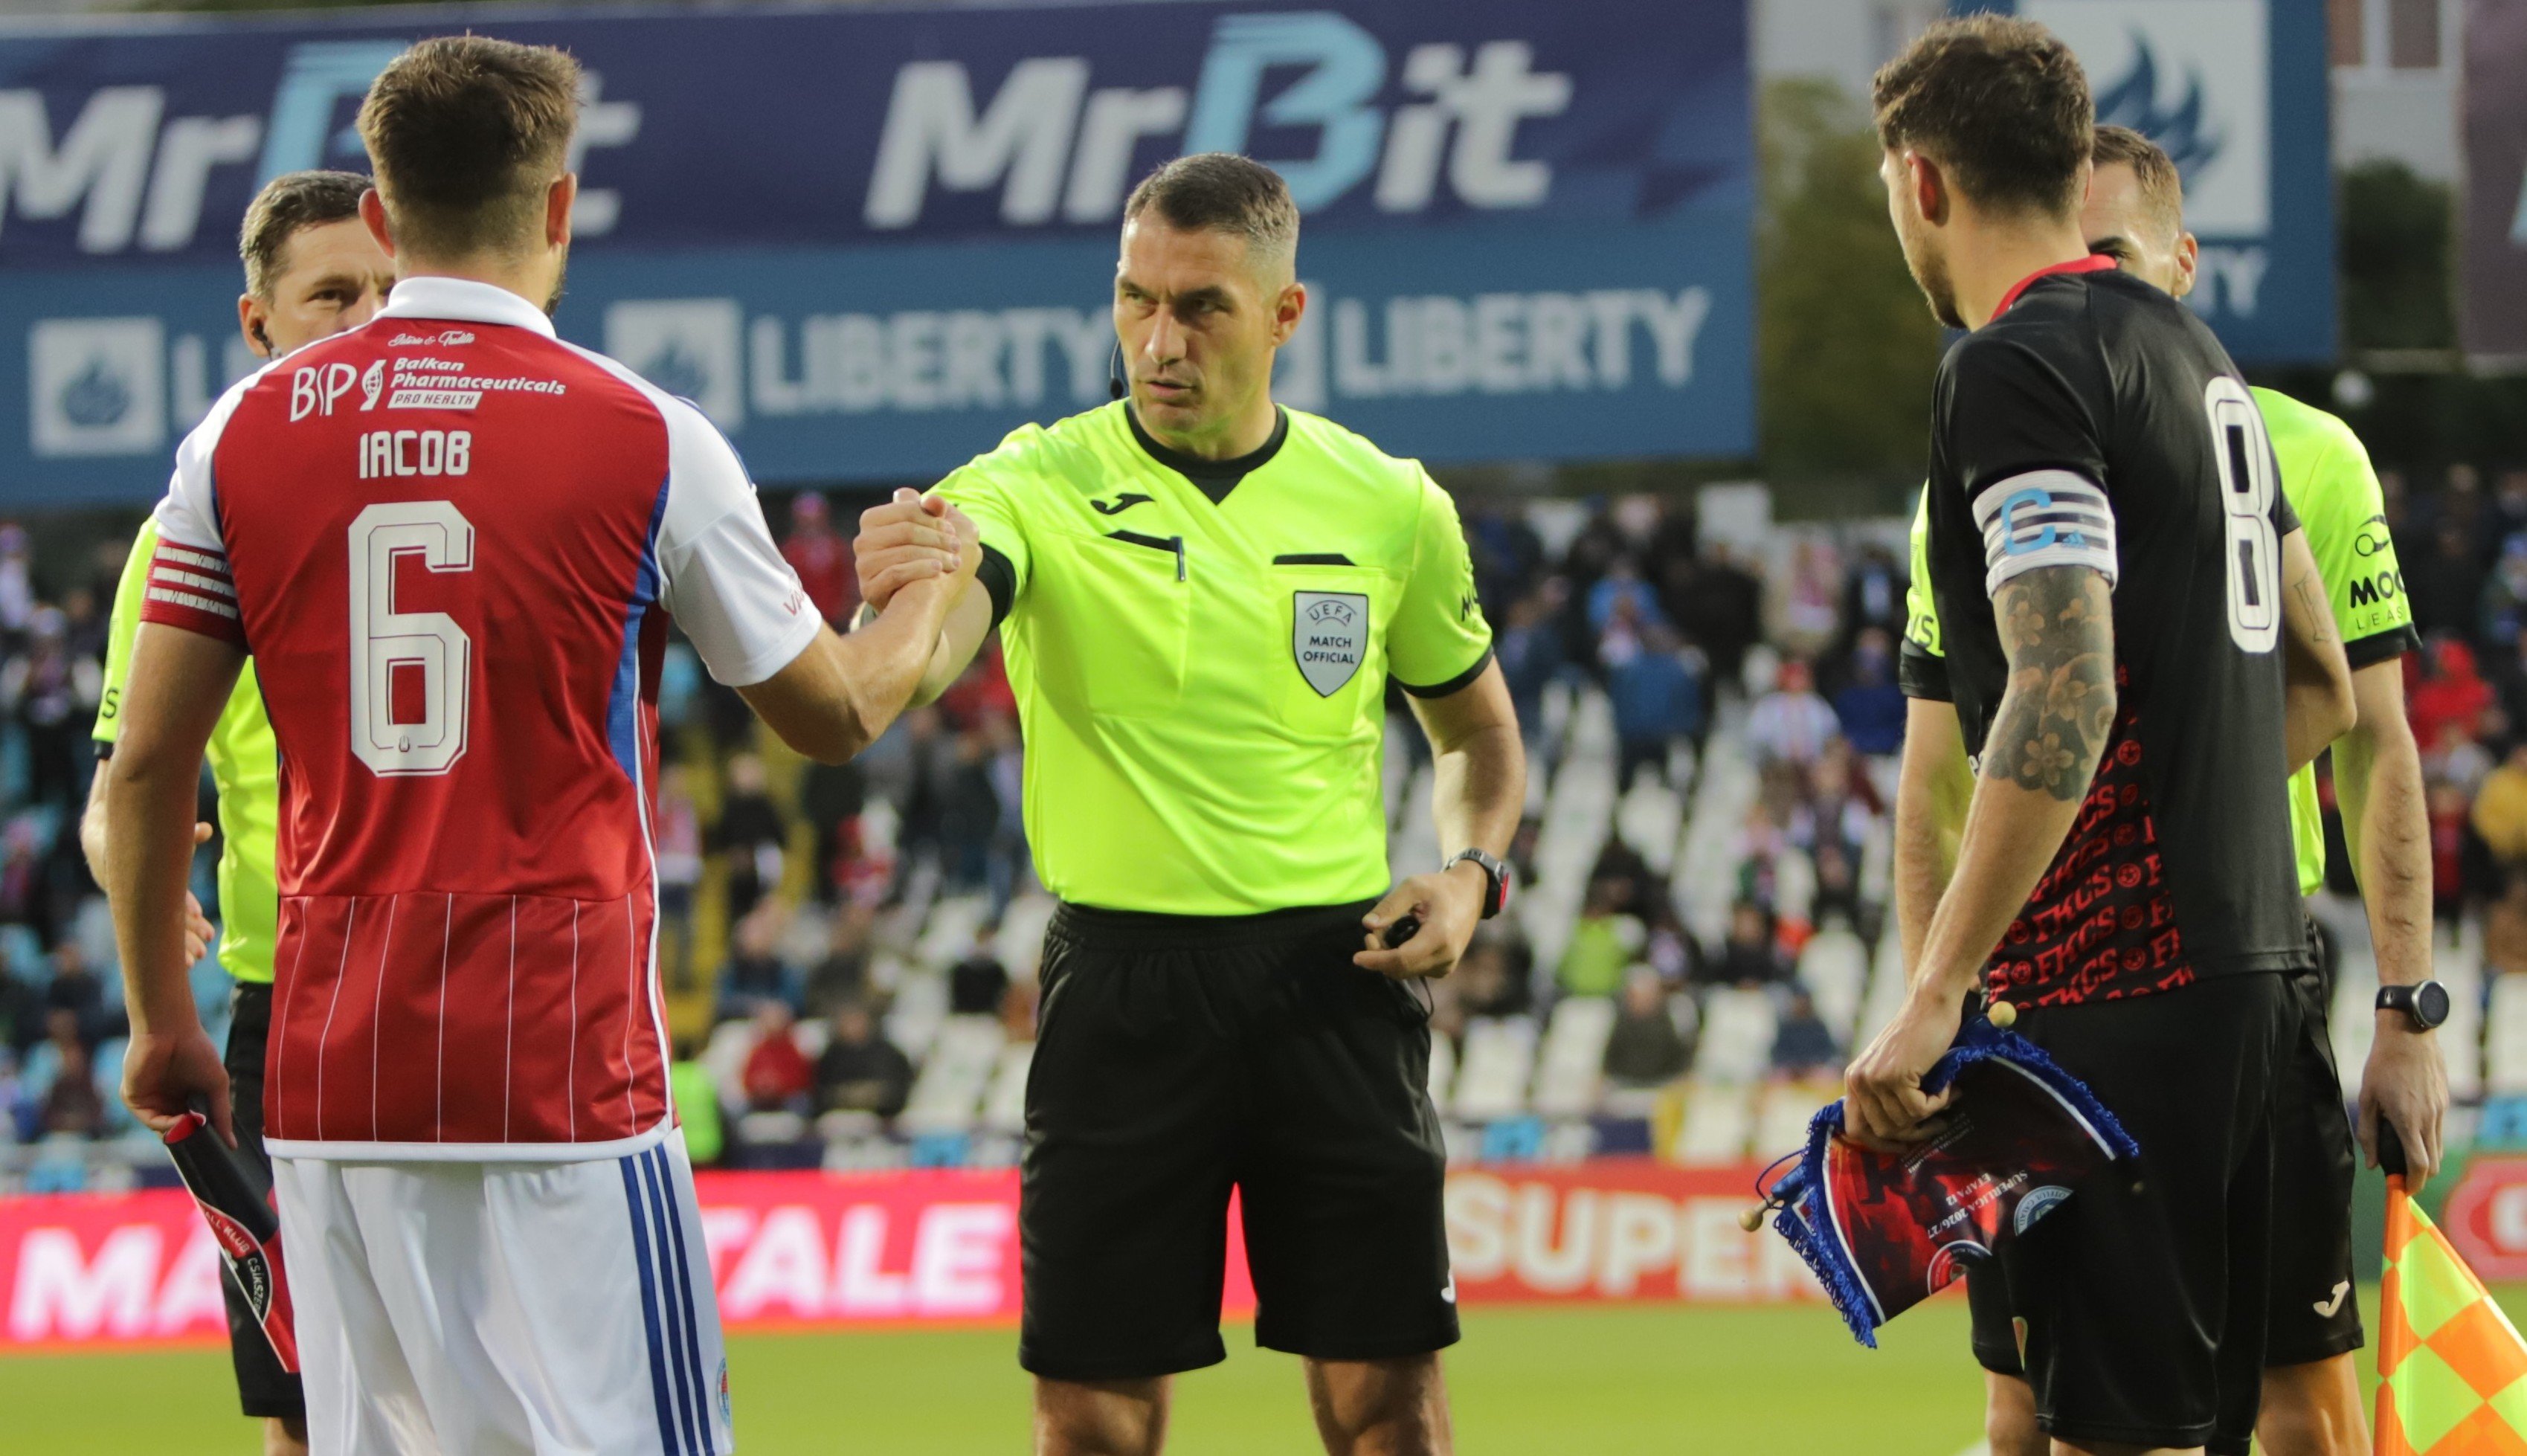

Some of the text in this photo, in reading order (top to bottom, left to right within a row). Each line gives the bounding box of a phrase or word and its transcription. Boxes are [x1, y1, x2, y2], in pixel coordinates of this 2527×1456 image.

[864, 10, 1574, 229] MrBit
[750, 306, 1116, 415] LIBERTY
[1336, 286, 1710, 399] LIBERTY
[390, 372, 567, 396] Pharmaceuticals
[393, 357, 465, 373] Balkan
[394, 393, 474, 405] PRO HEALTH
[359, 429, 472, 479] IACOB
[2000, 487, 2057, 556] C
[2205, 376, 2281, 654] 8
[1309, 603, 1353, 624] UEFA
[348, 500, 475, 779] 6
[1303, 651, 1355, 664] OFFICIAL
[1309, 636, 1352, 648] MATCH
[1945, 1172, 1992, 1206] ETAPA 12
[1967, 1169, 2029, 1213] SUPERLIGA
[224, 1225, 251, 1253] KLUB
